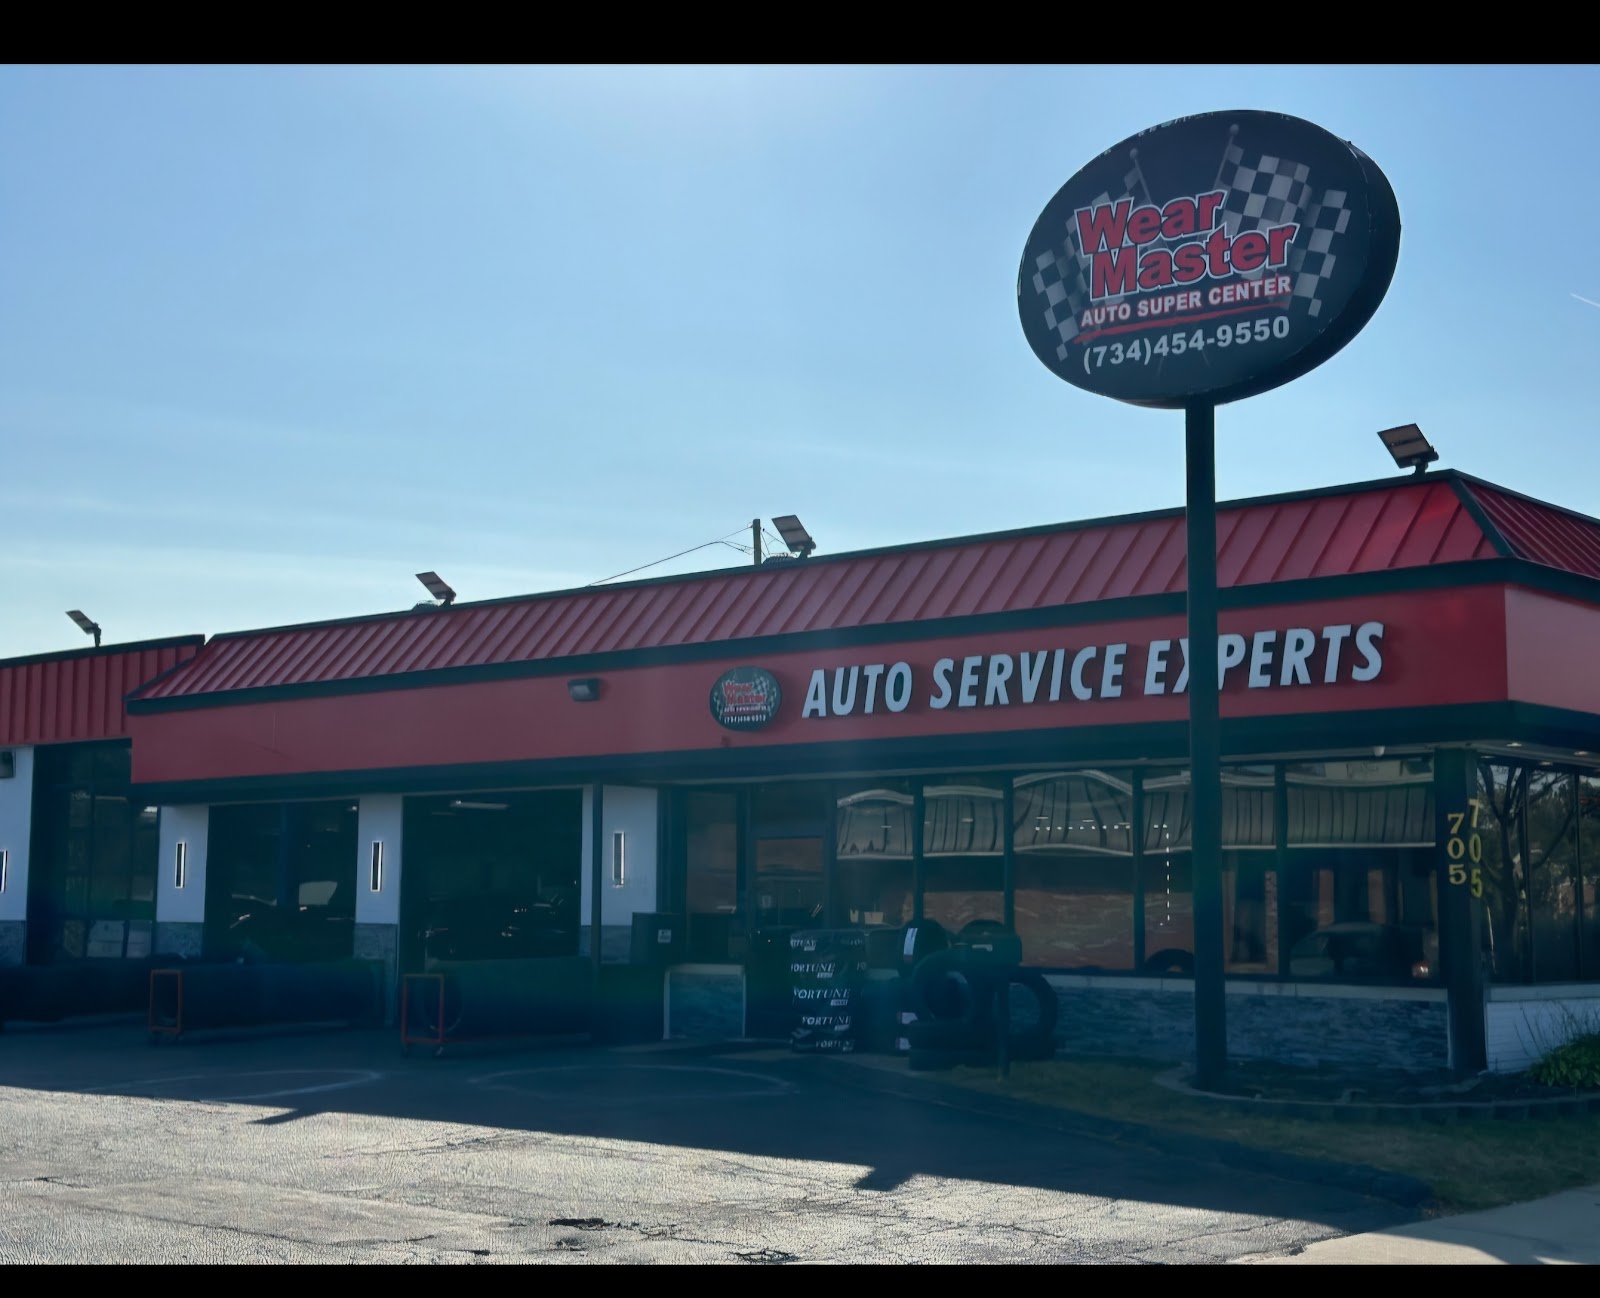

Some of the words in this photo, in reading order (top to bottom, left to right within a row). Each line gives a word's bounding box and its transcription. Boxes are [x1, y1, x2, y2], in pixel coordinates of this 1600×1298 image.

[1075, 190, 1227, 256] Wear
[1090, 223, 1300, 300] Master
[1081, 303, 1131, 327] AUTO
[1138, 291, 1202, 317] SUPER
[1208, 275, 1292, 305] CENTER
[1083, 315, 1291, 375] (734)454-9550
[802, 661, 912, 718] AUTO
[929, 643, 1128, 709] SERVICE
[1447, 812, 1467, 885] 705
[1468, 798, 1483, 898] 705
